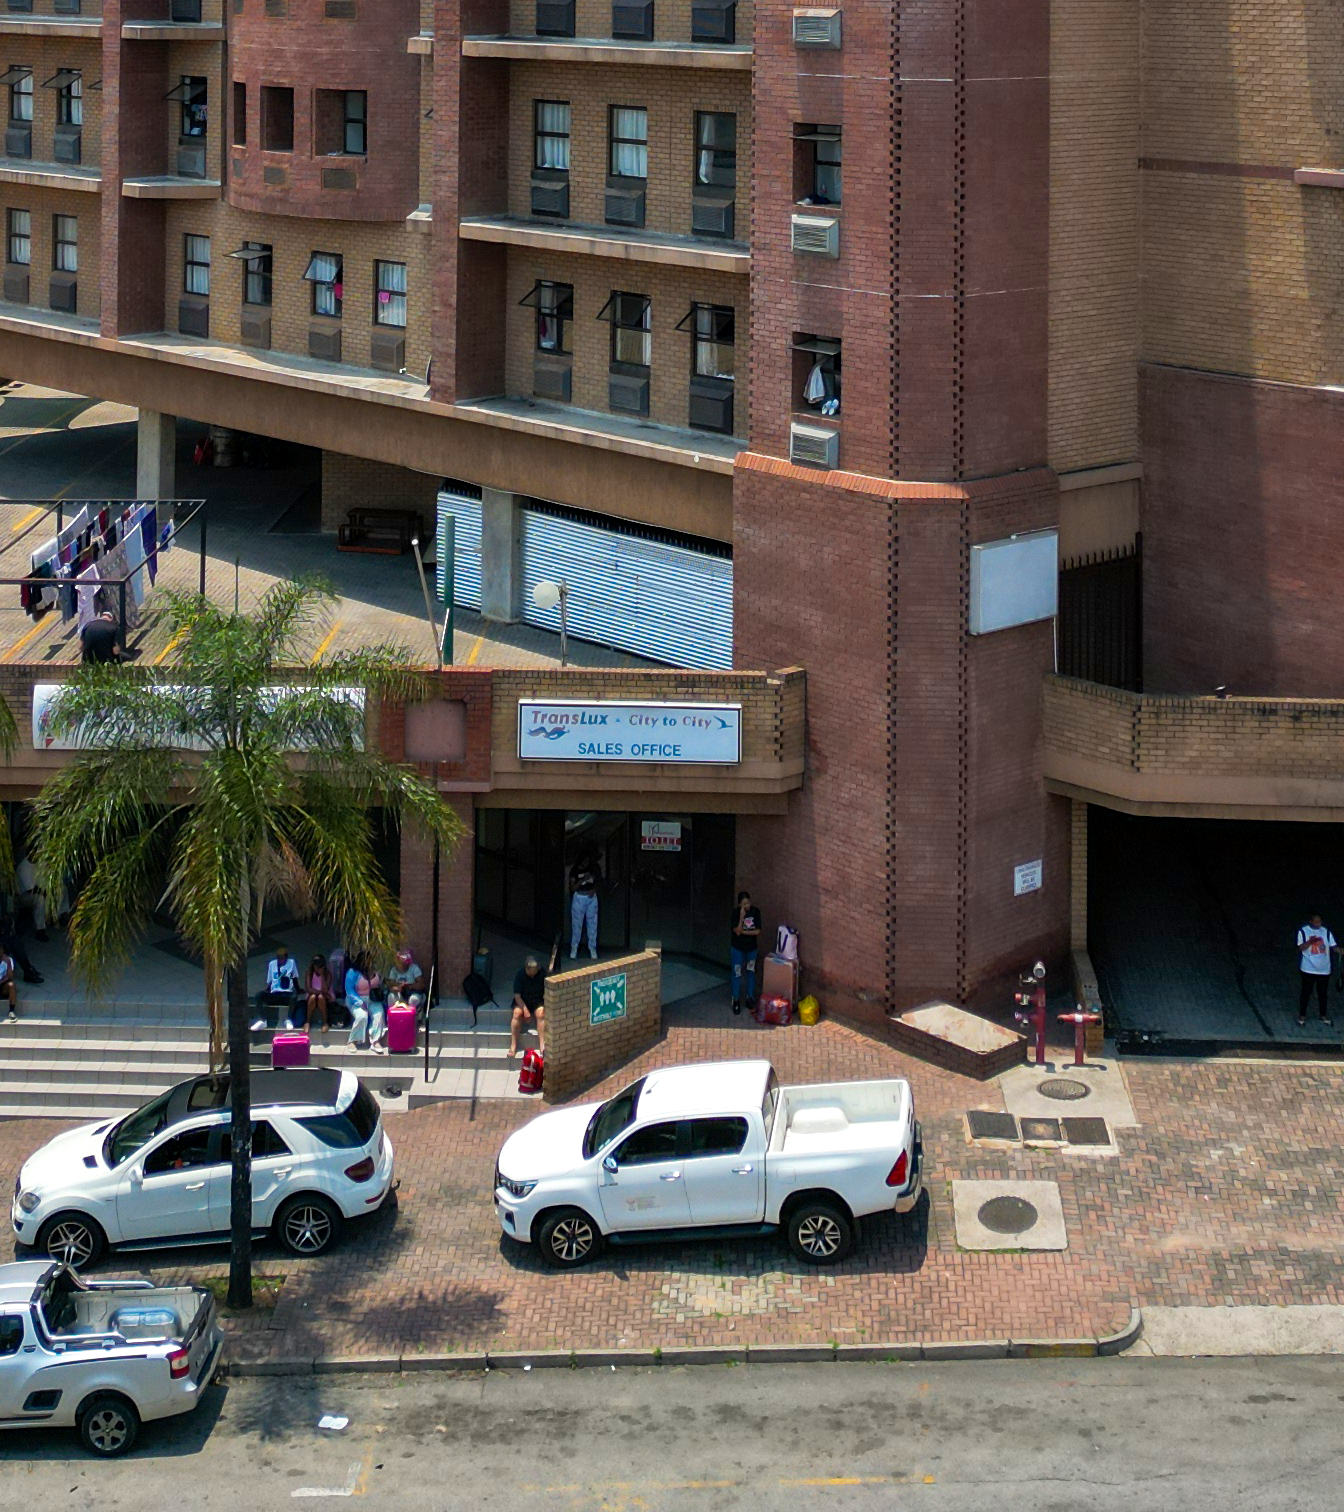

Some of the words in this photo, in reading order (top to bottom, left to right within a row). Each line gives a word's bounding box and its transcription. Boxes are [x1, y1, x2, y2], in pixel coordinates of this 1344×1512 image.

[531, 710, 609, 726] TransLux
[628, 714, 658, 729] City
[662, 716, 677, 727] to
[682, 715, 712, 730] City
[577, 742, 623, 756] SALES
[630, 743, 681, 757] OFFICE
